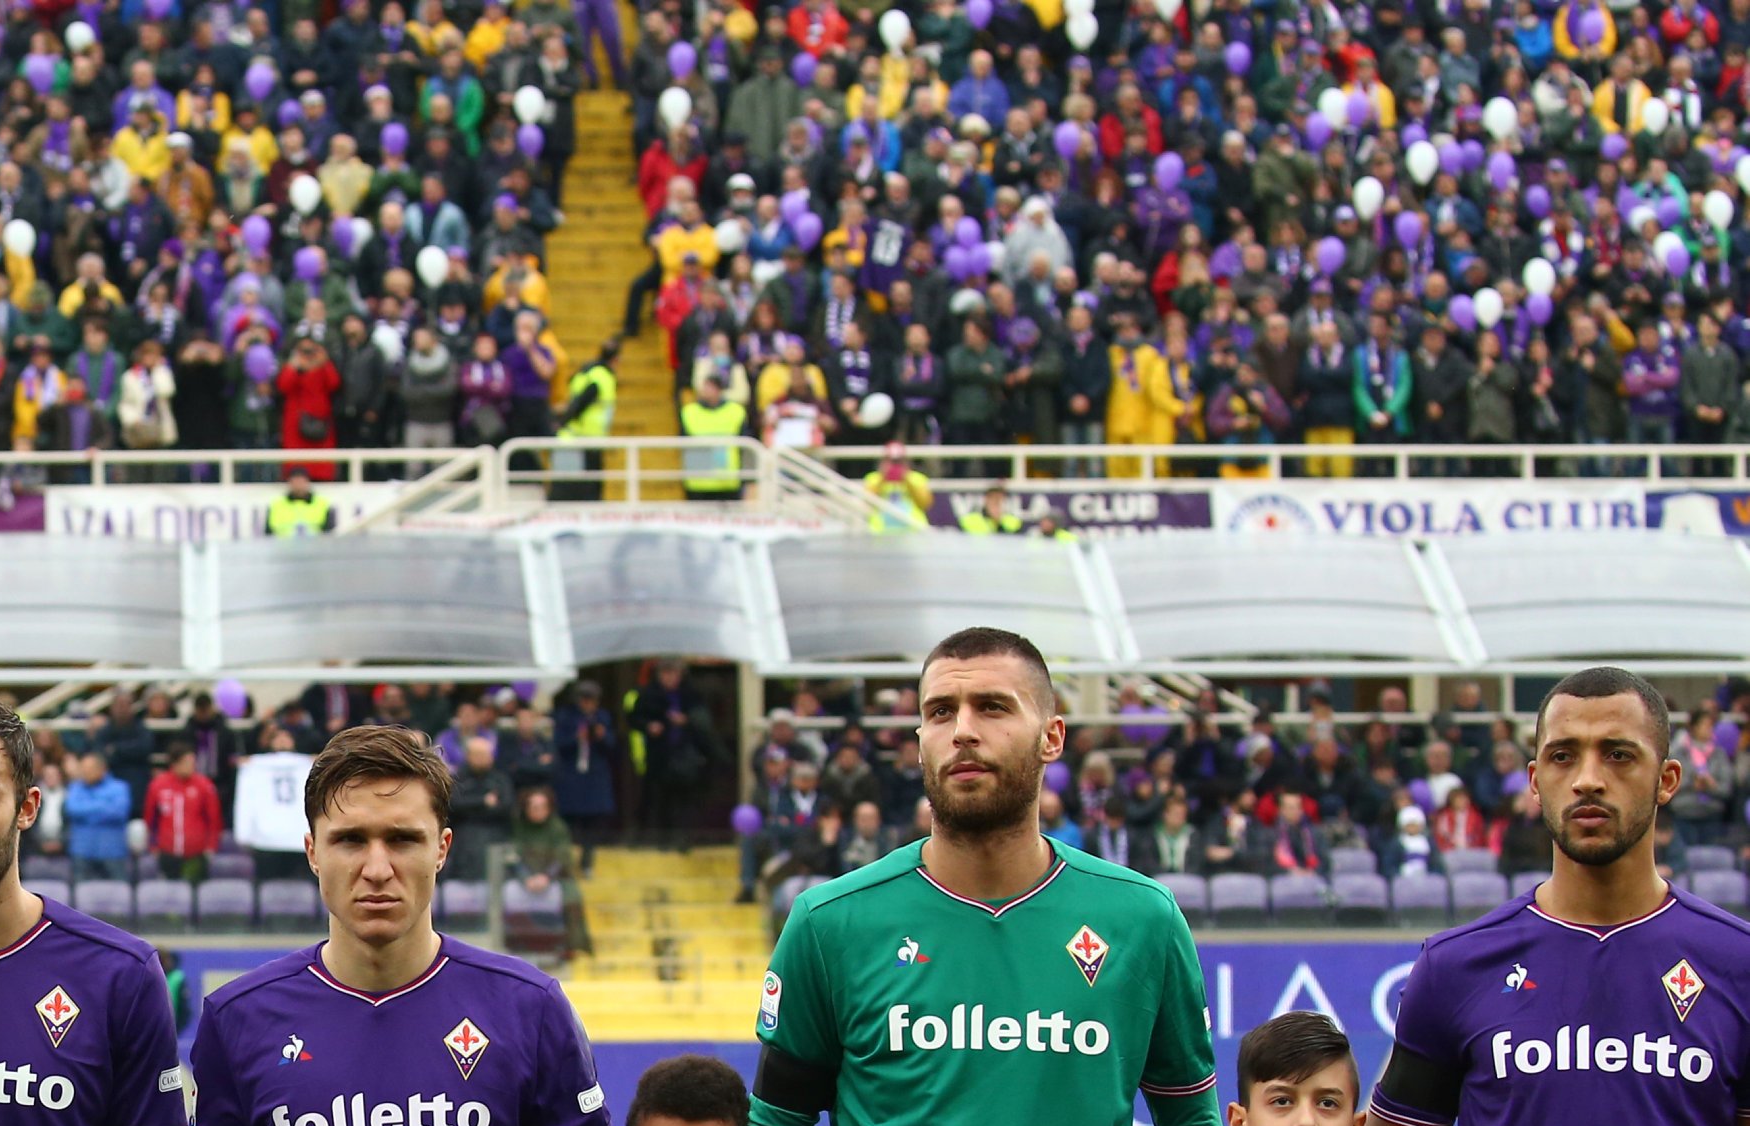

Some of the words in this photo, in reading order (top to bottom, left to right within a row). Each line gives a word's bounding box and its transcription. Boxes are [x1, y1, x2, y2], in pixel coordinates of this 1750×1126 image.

[1068, 492, 1160, 523] CLUB
[1321, 500, 1485, 534] VIOLA
[1503, 500, 1639, 531] CLUB
[888, 1003, 1111, 1056] folletto
[1491, 1024, 1715, 1084] folletto
